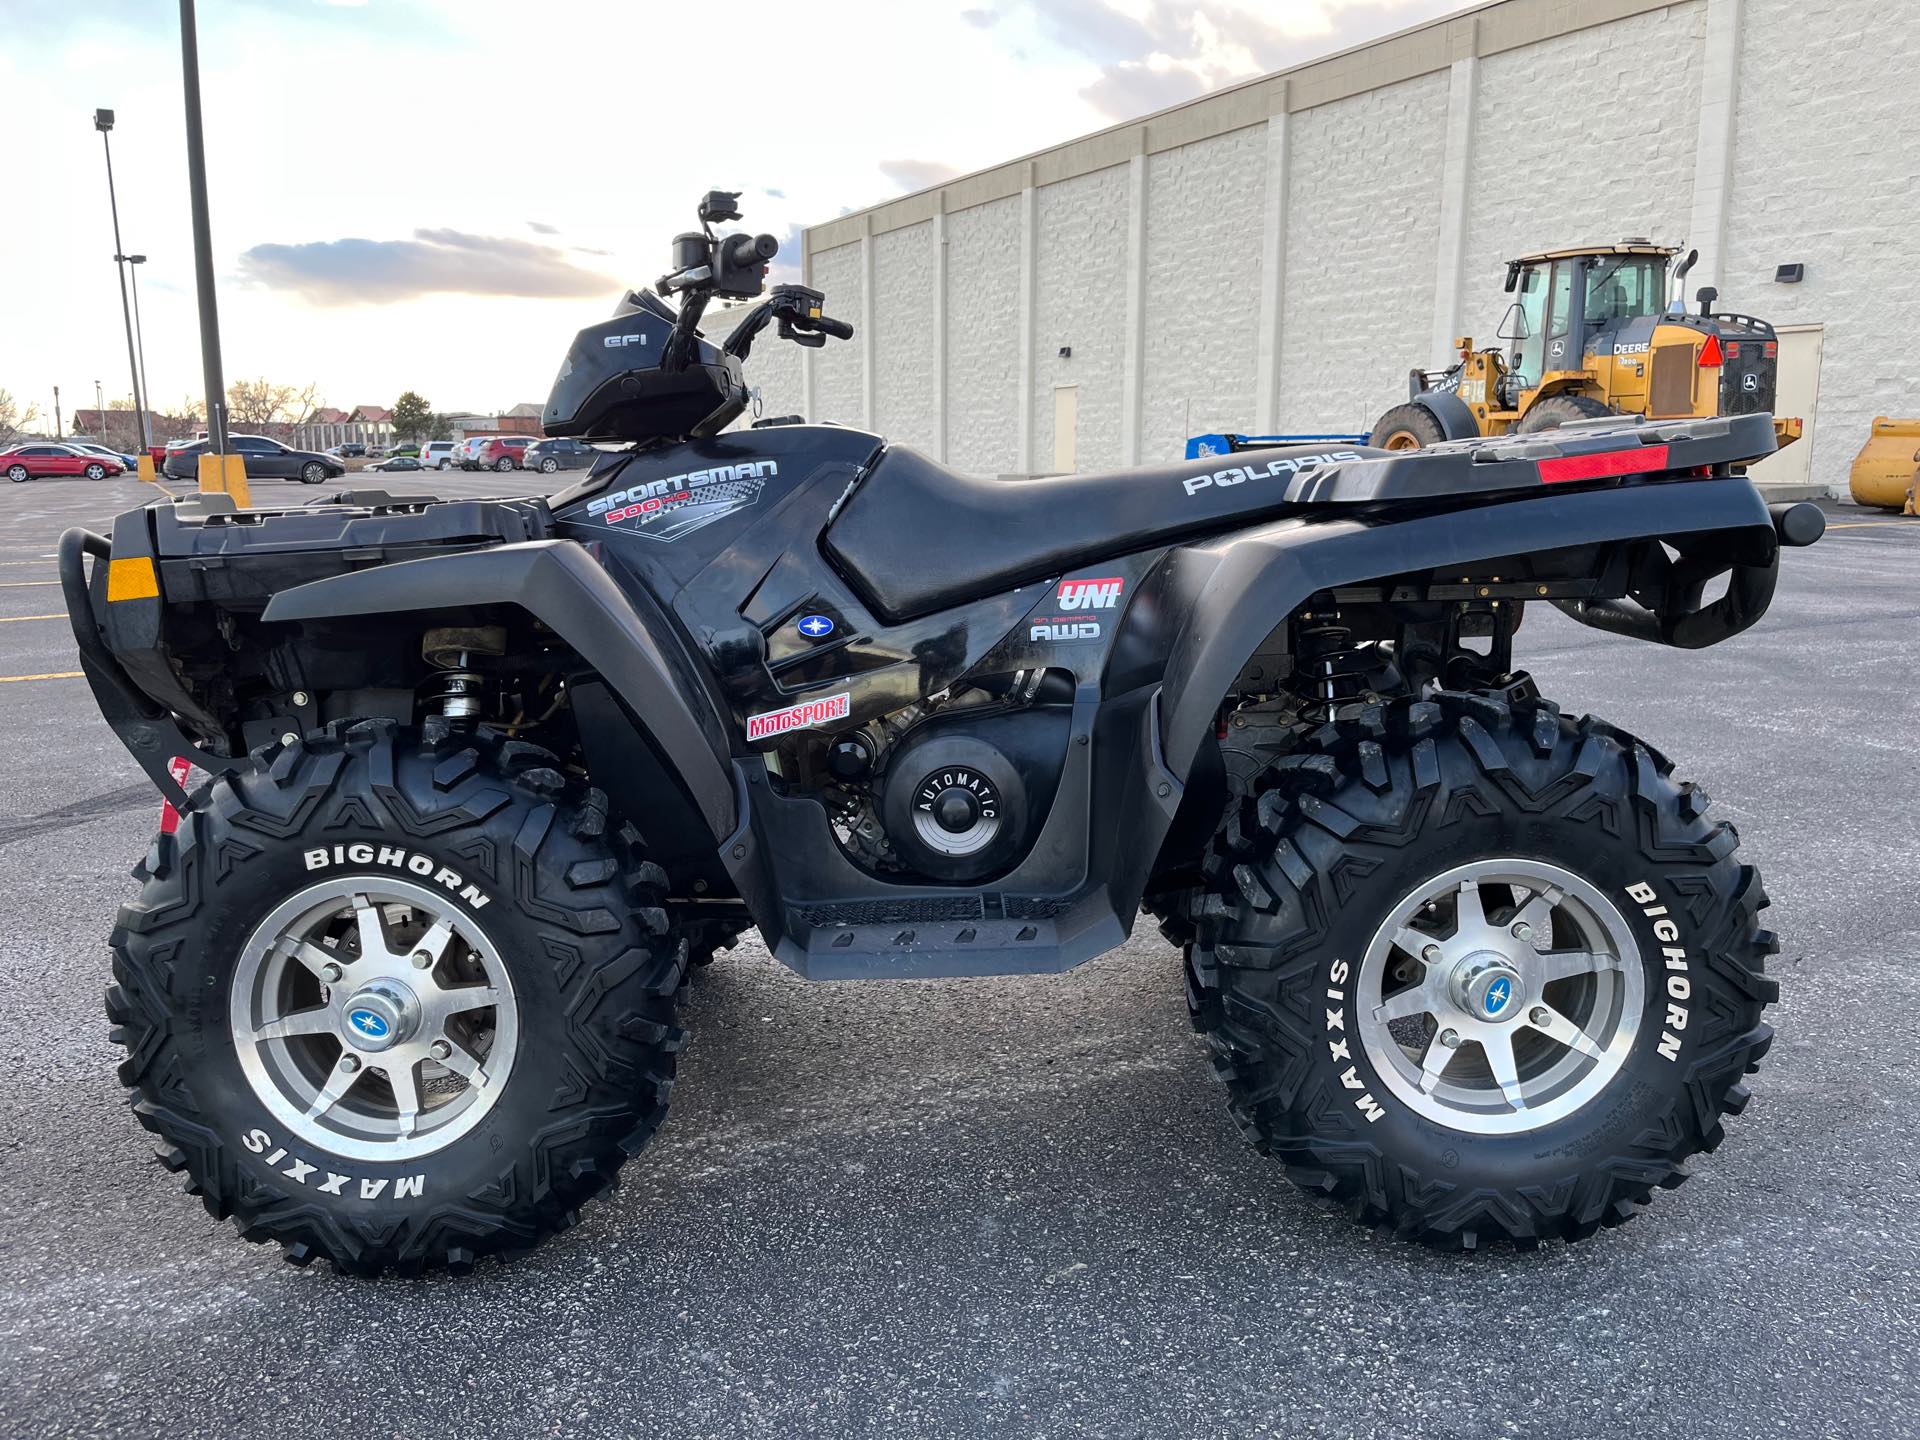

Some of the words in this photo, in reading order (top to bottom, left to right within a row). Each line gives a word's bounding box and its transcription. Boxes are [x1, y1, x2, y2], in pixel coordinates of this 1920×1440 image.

[604, 333, 647, 348] EFI
[1613, 342, 1649, 355] DEERE
[586, 460, 778, 518] SPORTSMAN
[1182, 451, 1363, 496] POLARIS
[605, 499, 661, 525] 500
[1059, 582, 1120, 611] UNI
[1030, 622, 1101, 642] AWD
[919, 772, 996, 819] AUTOMATIC
[303, 842, 492, 910] BIGHORN
[1624, 880, 1691, 1063] BIGHORN
[1325, 957, 1387, 1125] MAXXIS
[241, 1126, 426, 1201] MAXXIS
